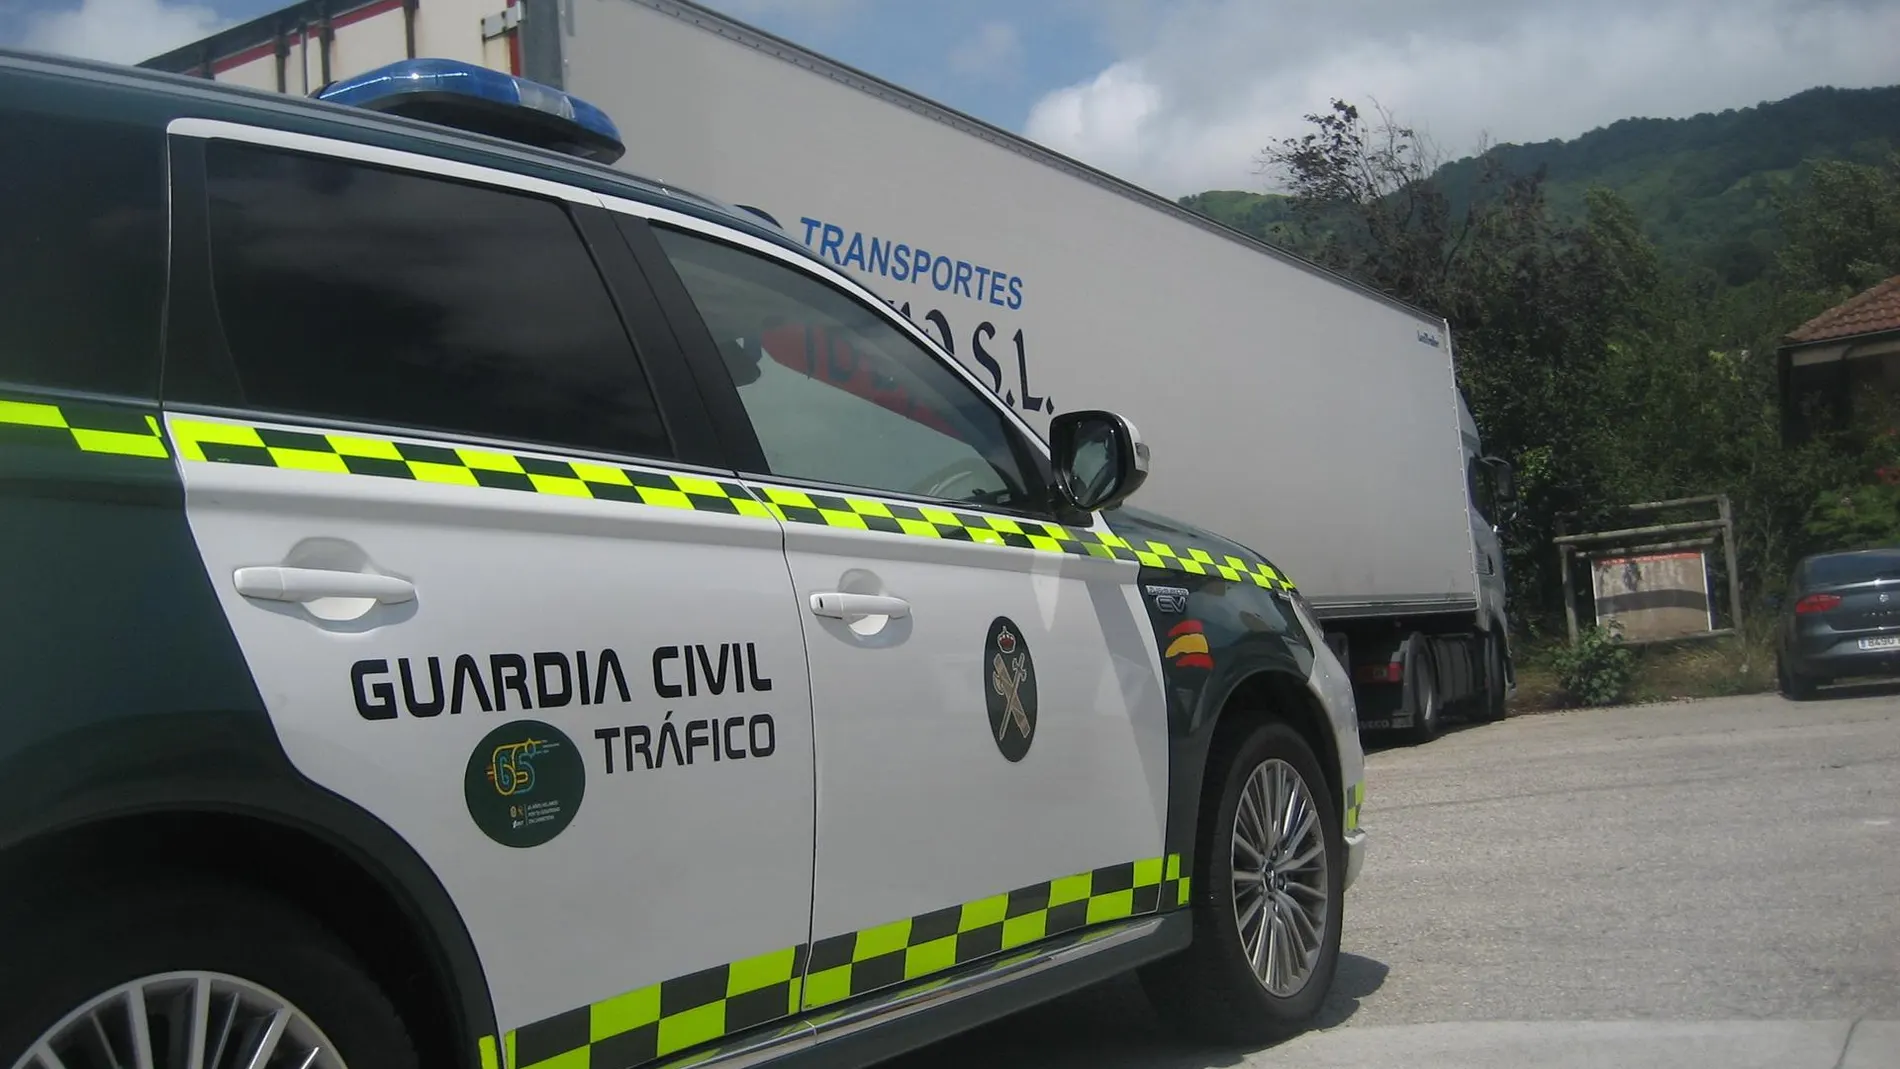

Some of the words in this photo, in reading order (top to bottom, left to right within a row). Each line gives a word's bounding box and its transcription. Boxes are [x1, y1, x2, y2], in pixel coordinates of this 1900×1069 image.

[800, 216, 1024, 310] TRANSPORTES
[1156, 595, 1186, 613] EV
[350, 648, 632, 721] GUARDIA
[652, 642, 773, 699] CIVIL
[594, 711, 776, 774] TRÁFICO
